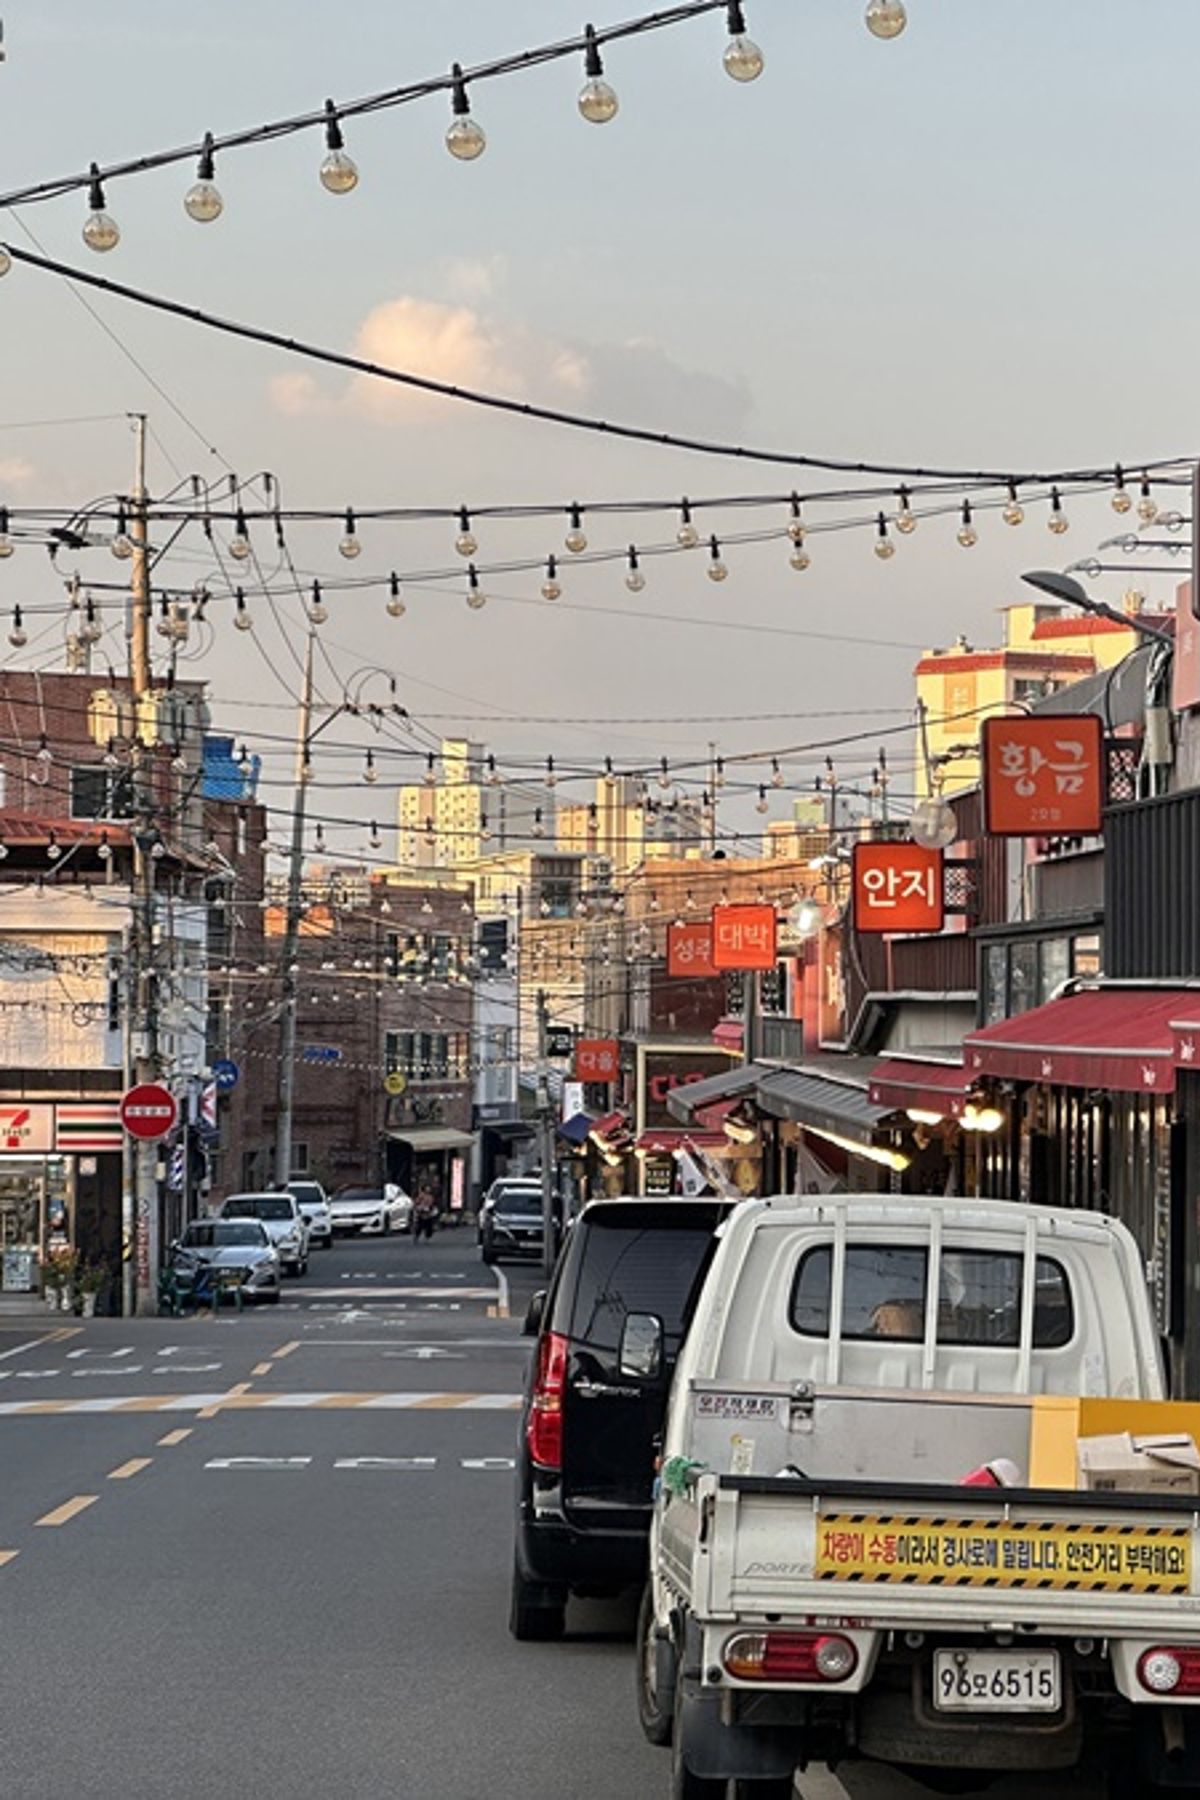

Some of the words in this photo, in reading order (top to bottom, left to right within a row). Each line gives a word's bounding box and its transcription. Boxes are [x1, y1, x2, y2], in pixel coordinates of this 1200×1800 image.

[999, 740, 1091, 797] 황금
[863, 867, 936, 908] 안지
[719, 922, 769, 952] 대박
[822, 1532, 864, 1564] 차량이
[868, 1535, 939, 1566] 수동이라서
[943, 1538, 998, 1568] 경사로에
[1002, 1541, 1062, 1571] 밀립니다.
[1066, 1544, 1122, 1574] 안전거리
[1125, 1546, 1185, 1577] 부탁해요!
